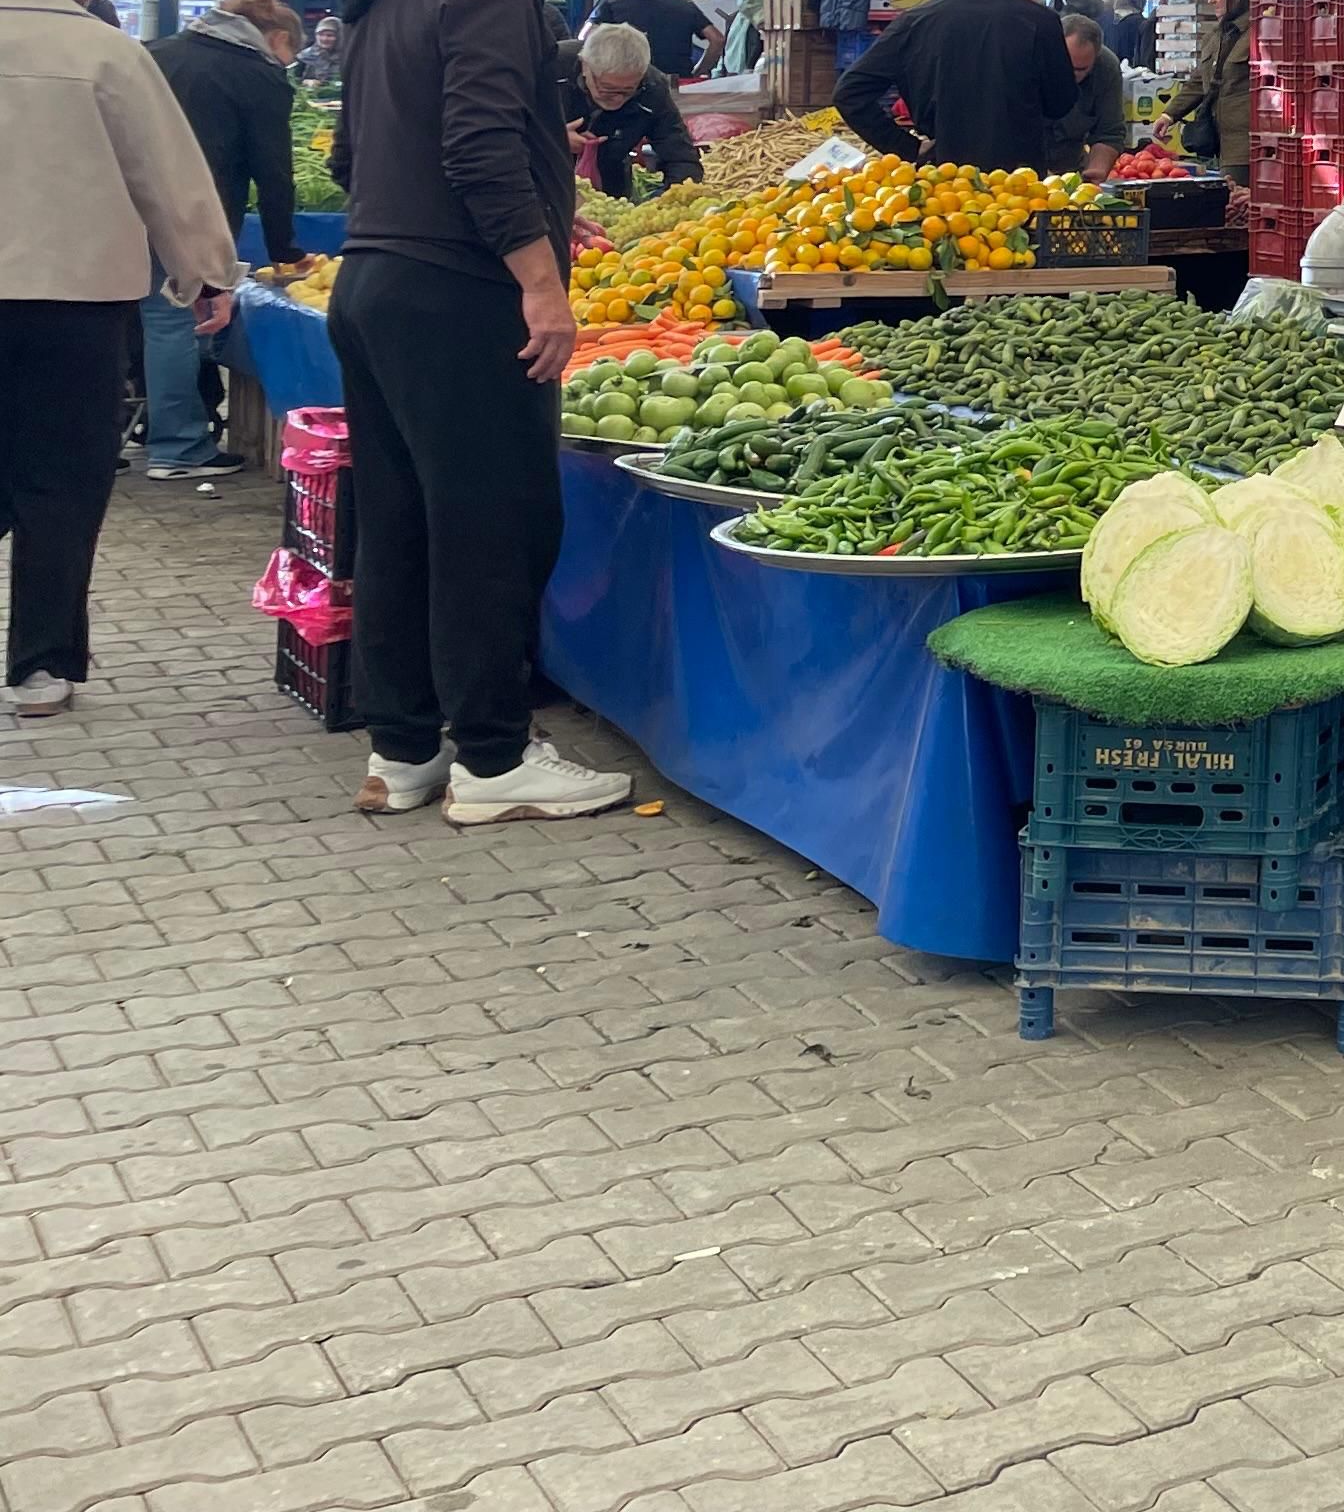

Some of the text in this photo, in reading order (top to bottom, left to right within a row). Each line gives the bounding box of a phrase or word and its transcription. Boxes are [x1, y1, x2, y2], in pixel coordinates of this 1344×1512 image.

[1124, 738, 1208, 752] BURSA 61
[1095, 748, 1160, 768] FRESH
